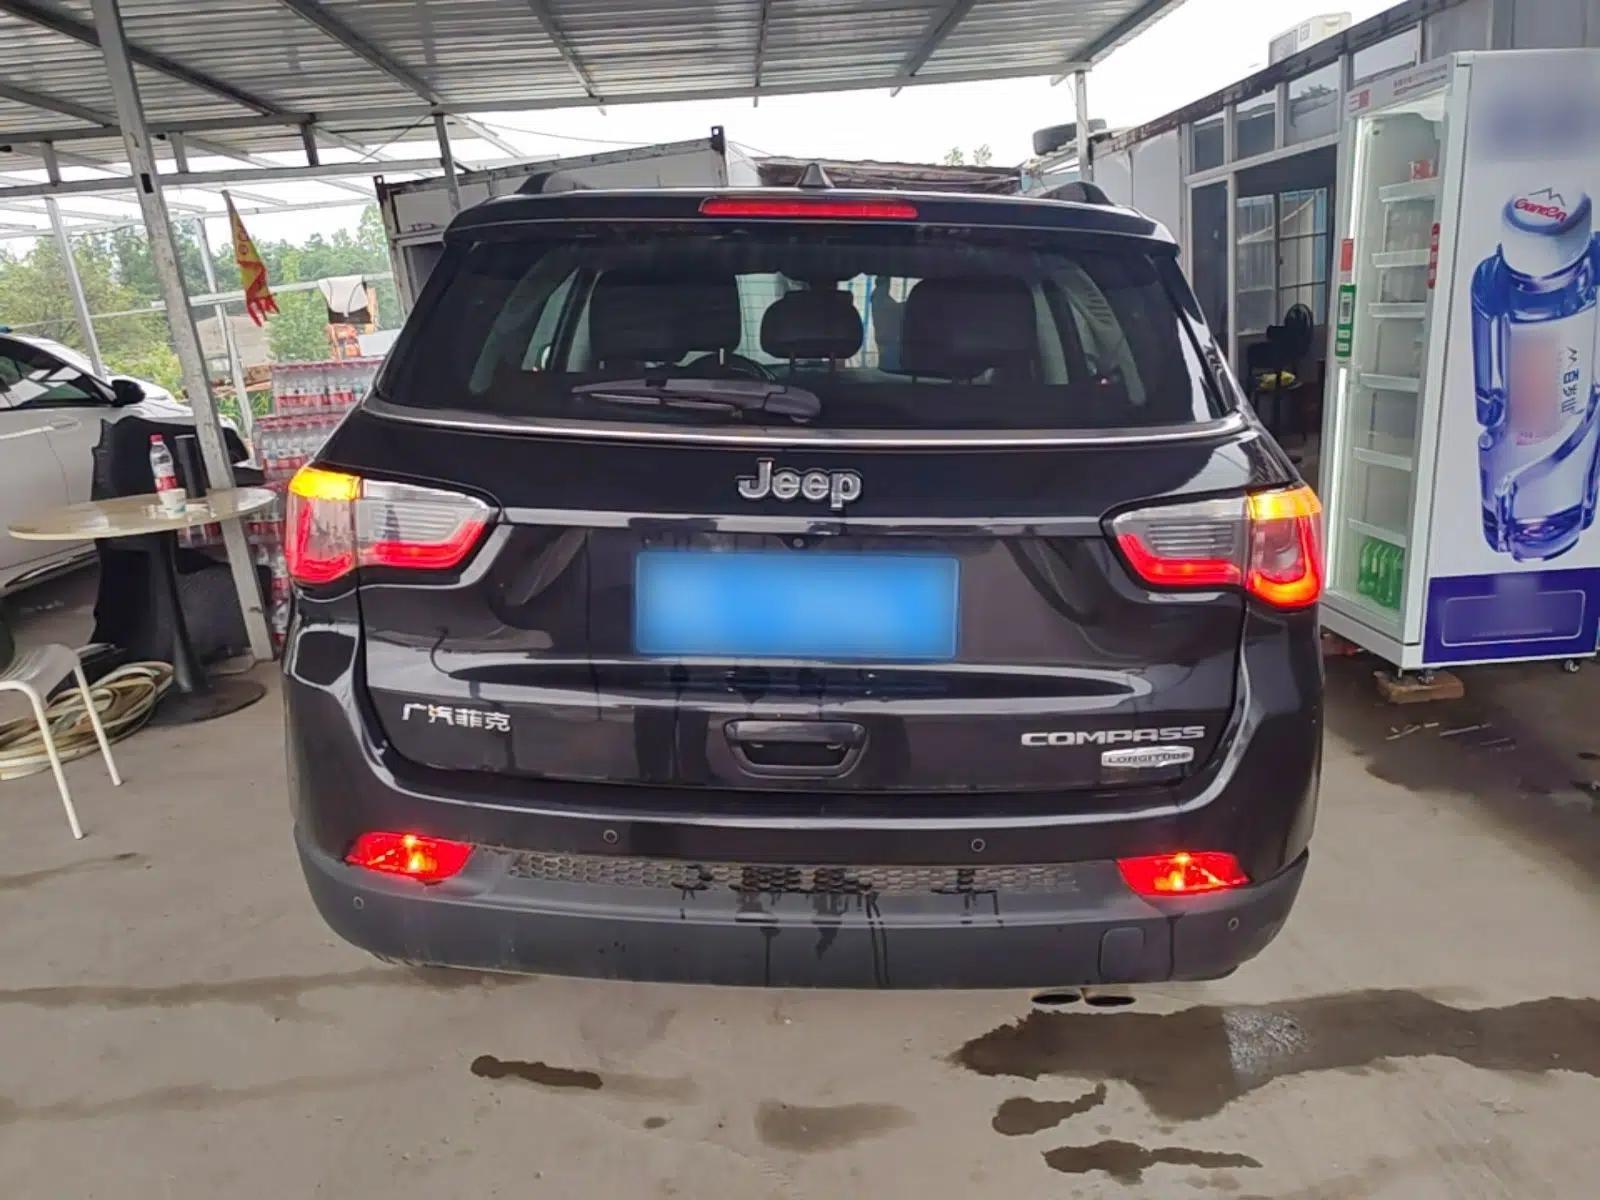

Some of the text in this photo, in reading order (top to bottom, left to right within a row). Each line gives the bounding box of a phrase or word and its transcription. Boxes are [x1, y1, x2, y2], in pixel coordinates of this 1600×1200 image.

[737, 459, 862, 508] Jeep
[402, 703, 511, 732] 广汽菲克
[1021, 726, 1205, 746] COMPASS
